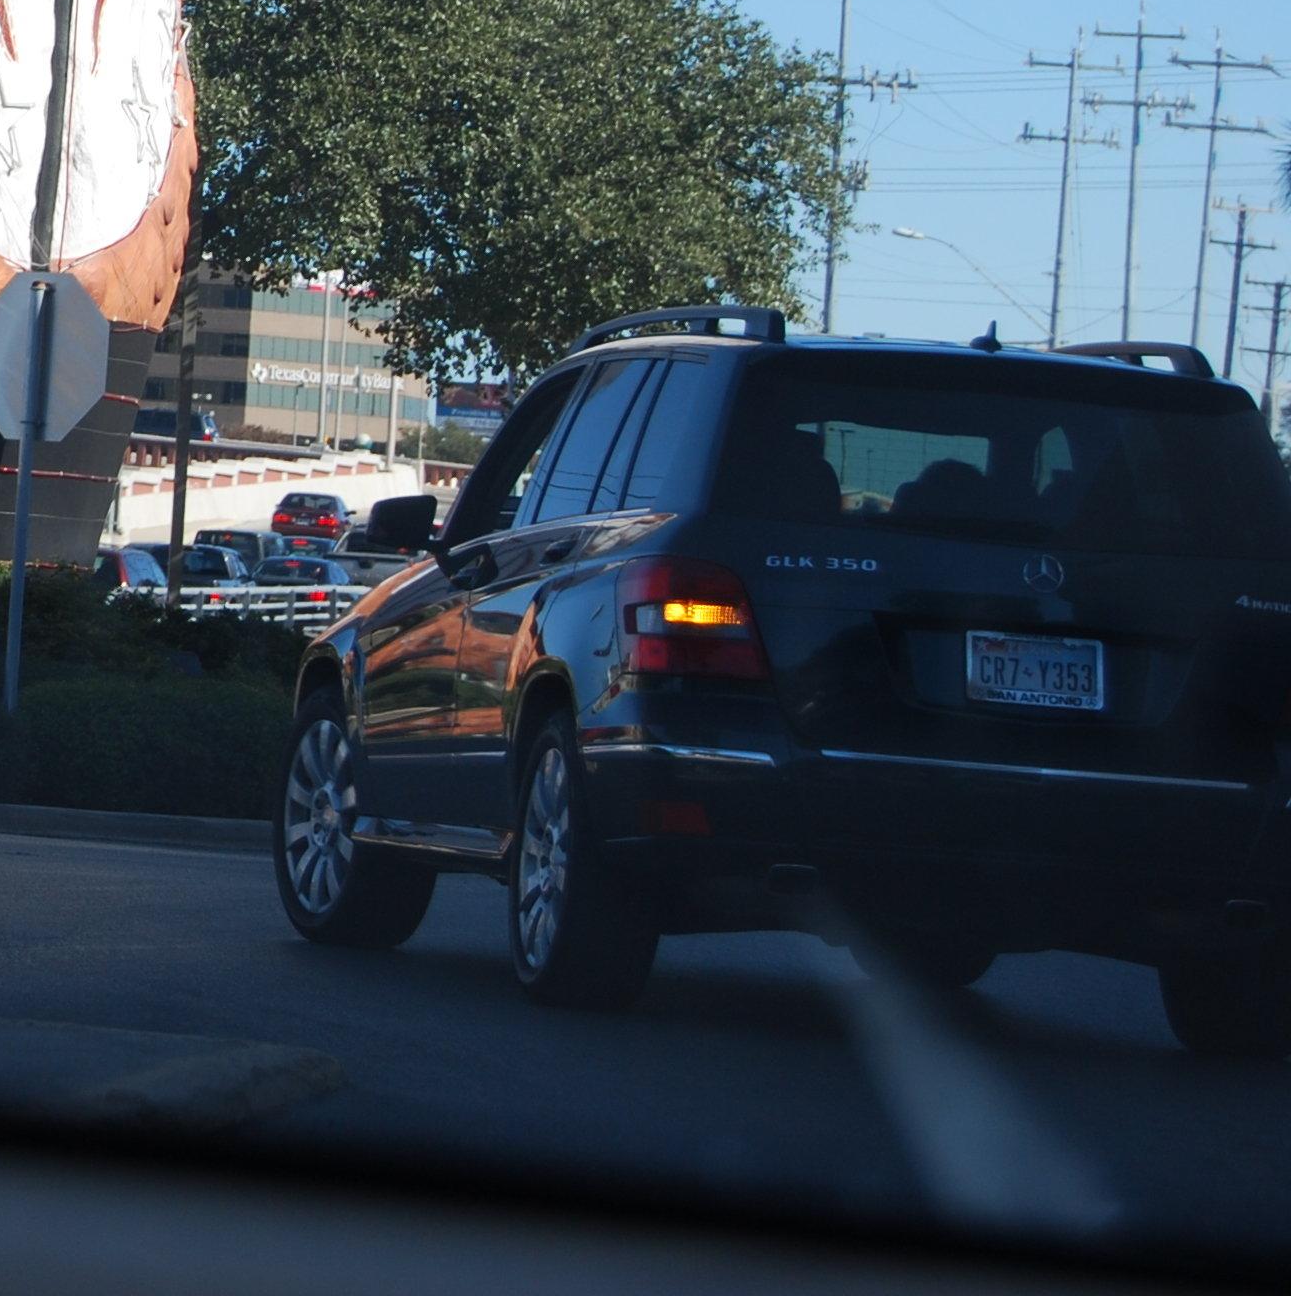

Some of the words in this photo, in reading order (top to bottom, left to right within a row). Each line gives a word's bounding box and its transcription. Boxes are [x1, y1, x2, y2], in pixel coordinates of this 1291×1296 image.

[765, 555, 815, 569] GLK
[825, 556, 878, 572] 350
[1020, 692, 1083, 707] ANTONIO
